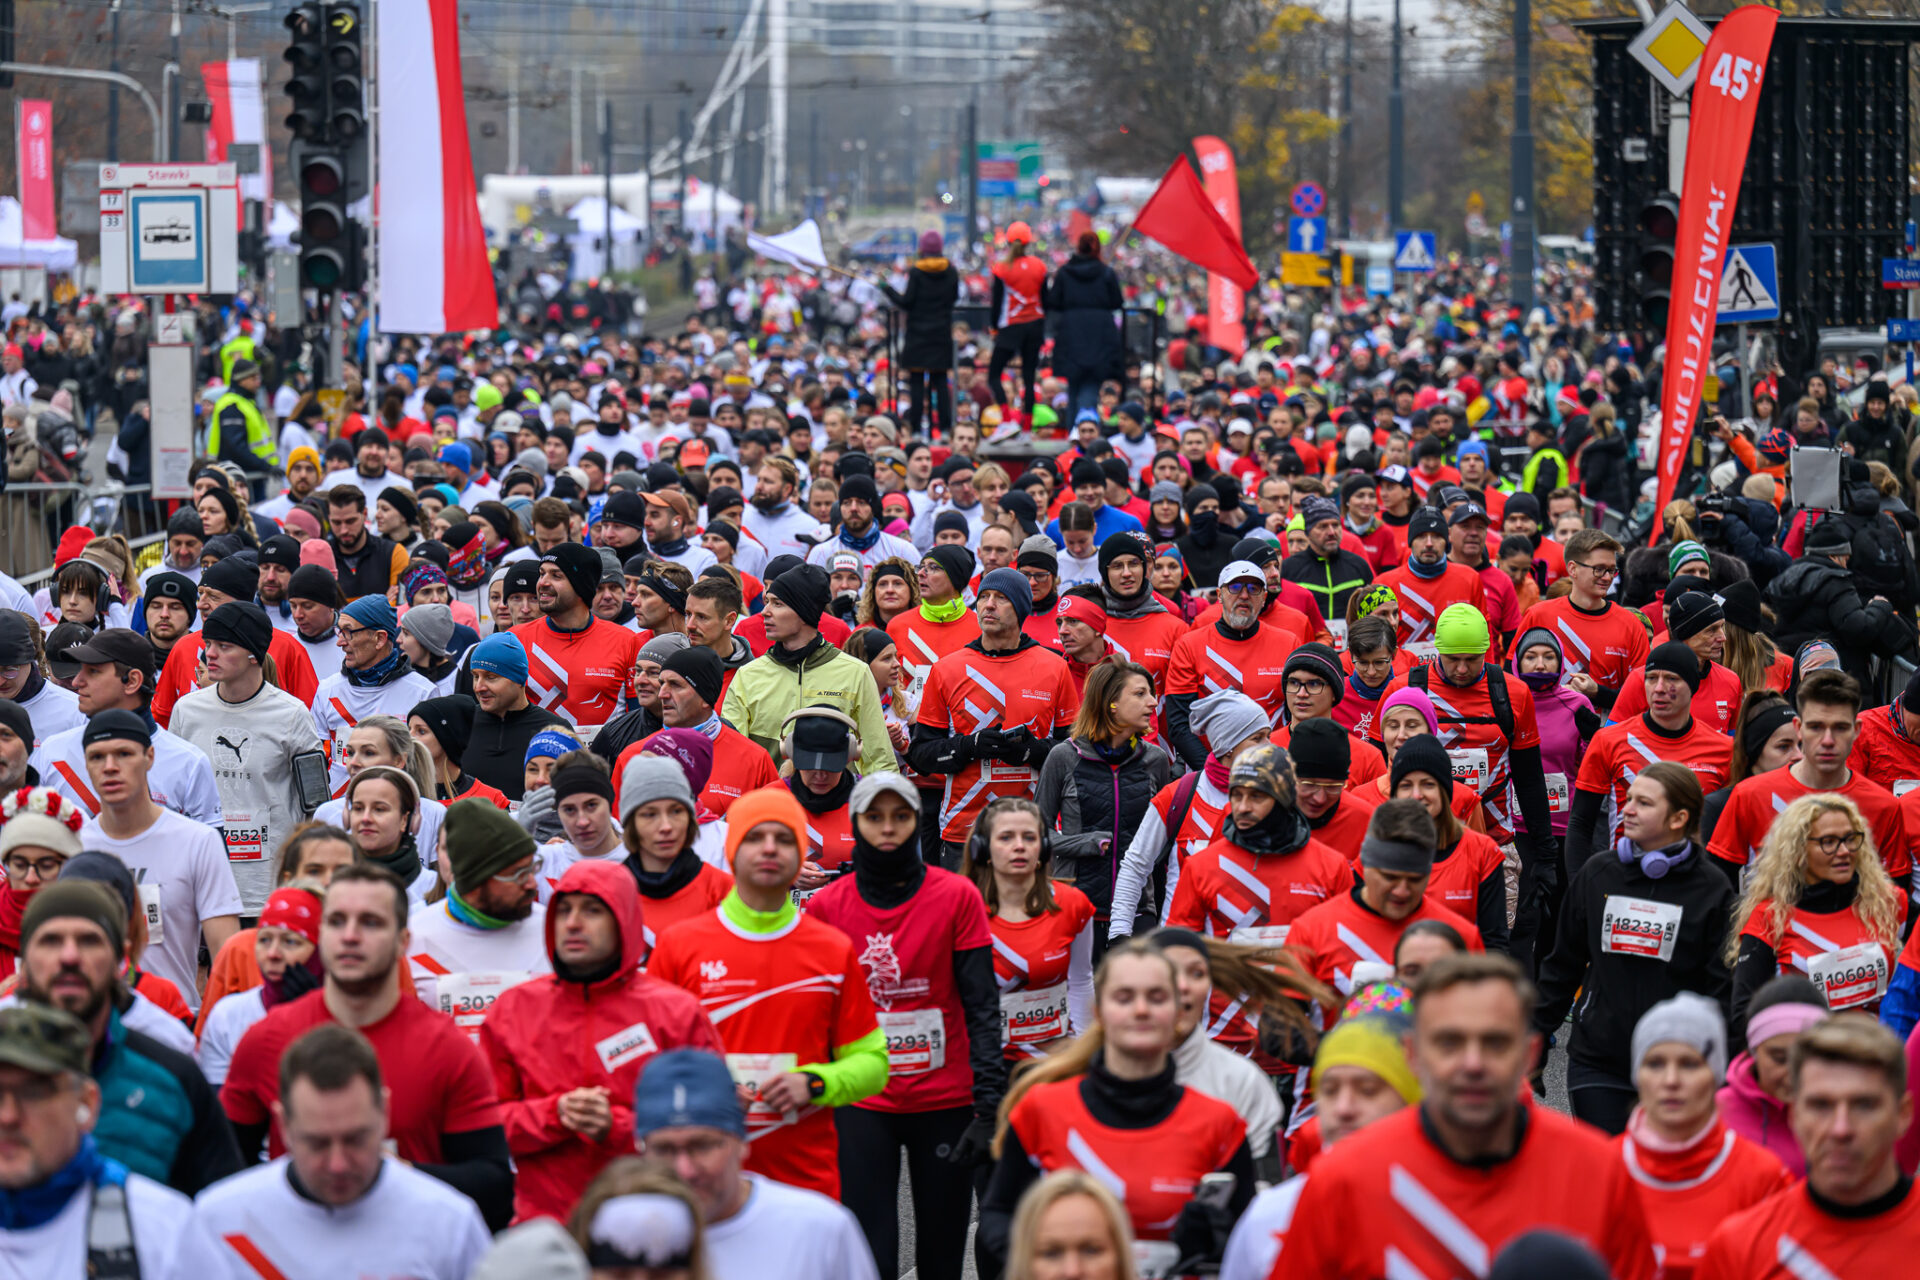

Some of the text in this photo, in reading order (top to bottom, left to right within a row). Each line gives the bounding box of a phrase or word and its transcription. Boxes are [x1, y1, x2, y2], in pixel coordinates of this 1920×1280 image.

[147, 169, 190, 181] Stawki
[106, 194, 118, 206] 17
[105, 215, 119, 228] 33
[223, 829, 260, 843] 7552
[1614, 916, 1663, 938] 18233
[1826, 963, 1876, 988] 10603
[1015, 1007, 1055, 1024] 9194
